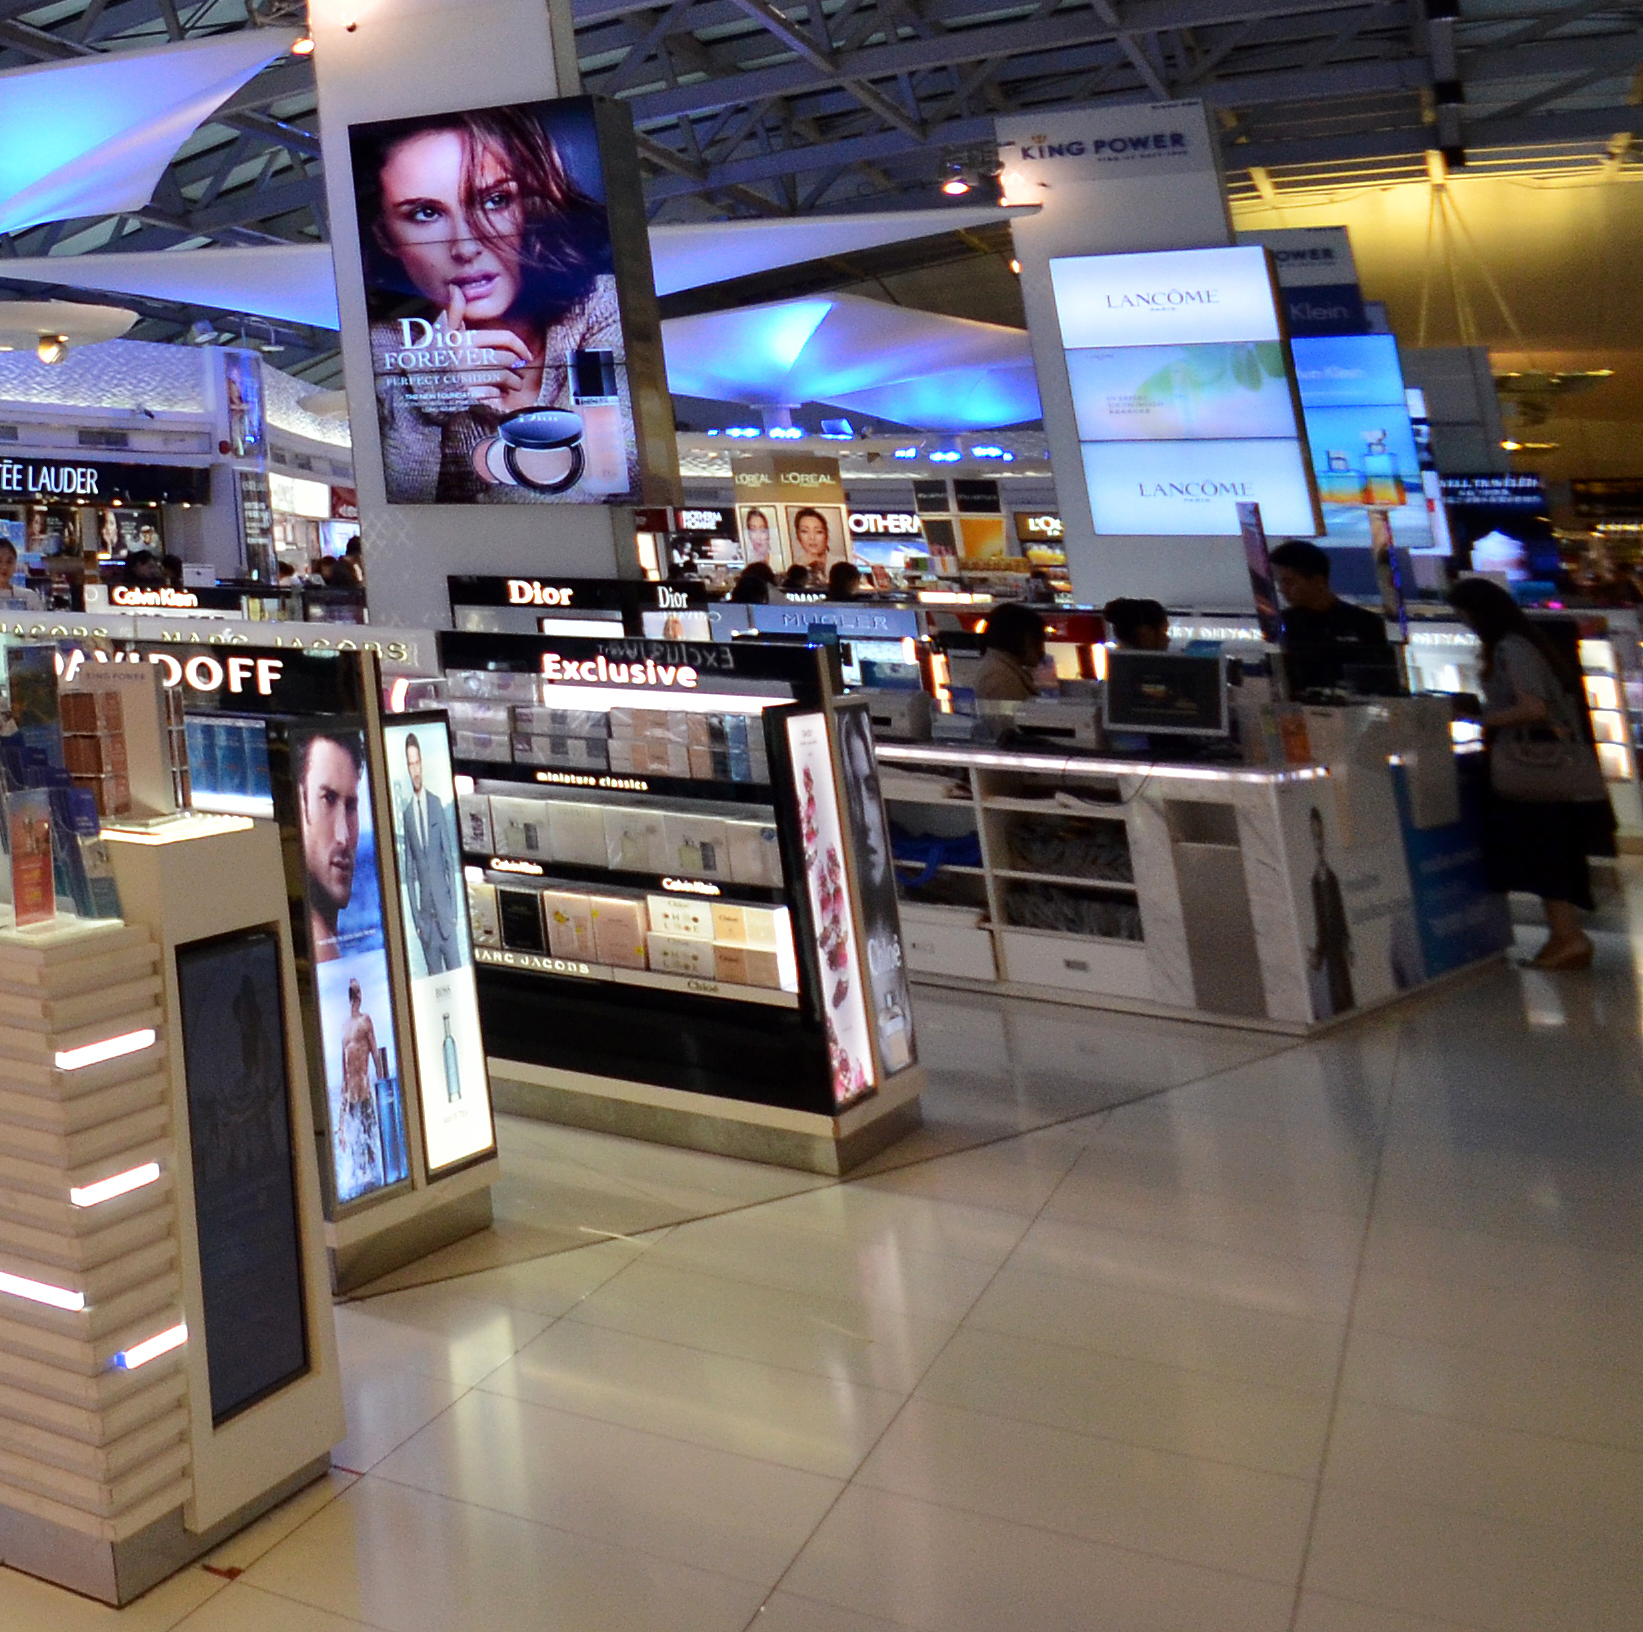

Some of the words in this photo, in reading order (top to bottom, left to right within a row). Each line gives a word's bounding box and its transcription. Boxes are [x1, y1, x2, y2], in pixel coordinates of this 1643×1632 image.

[1021, 141, 1085, 160] KING
[1093, 132, 1186, 154] POWER
[1106, 288, 1220, 309] LANCÔME
[1290, 302, 1349, 320] Klein
[397, 317, 477, 350] Dior
[385, 348, 498, 369] FOREVER
[386, 374, 439, 386] PERFECT
[28, 466, 99, 494] LAUDER
[1139, 479, 1256, 497] LANCÔME
[114, 585, 160, 606] Calvin
[160, 588, 198, 607] Klein
[508, 580, 574, 606] Dior
[658, 585, 689, 609] Dior
[782, 612, 888, 630] MUGLER
[542, 653, 699, 688] Exclusive
[536, 771, 596, 786] miniature
[598, 776, 649, 791] classics
[520, 955, 590, 974] JACOBS
